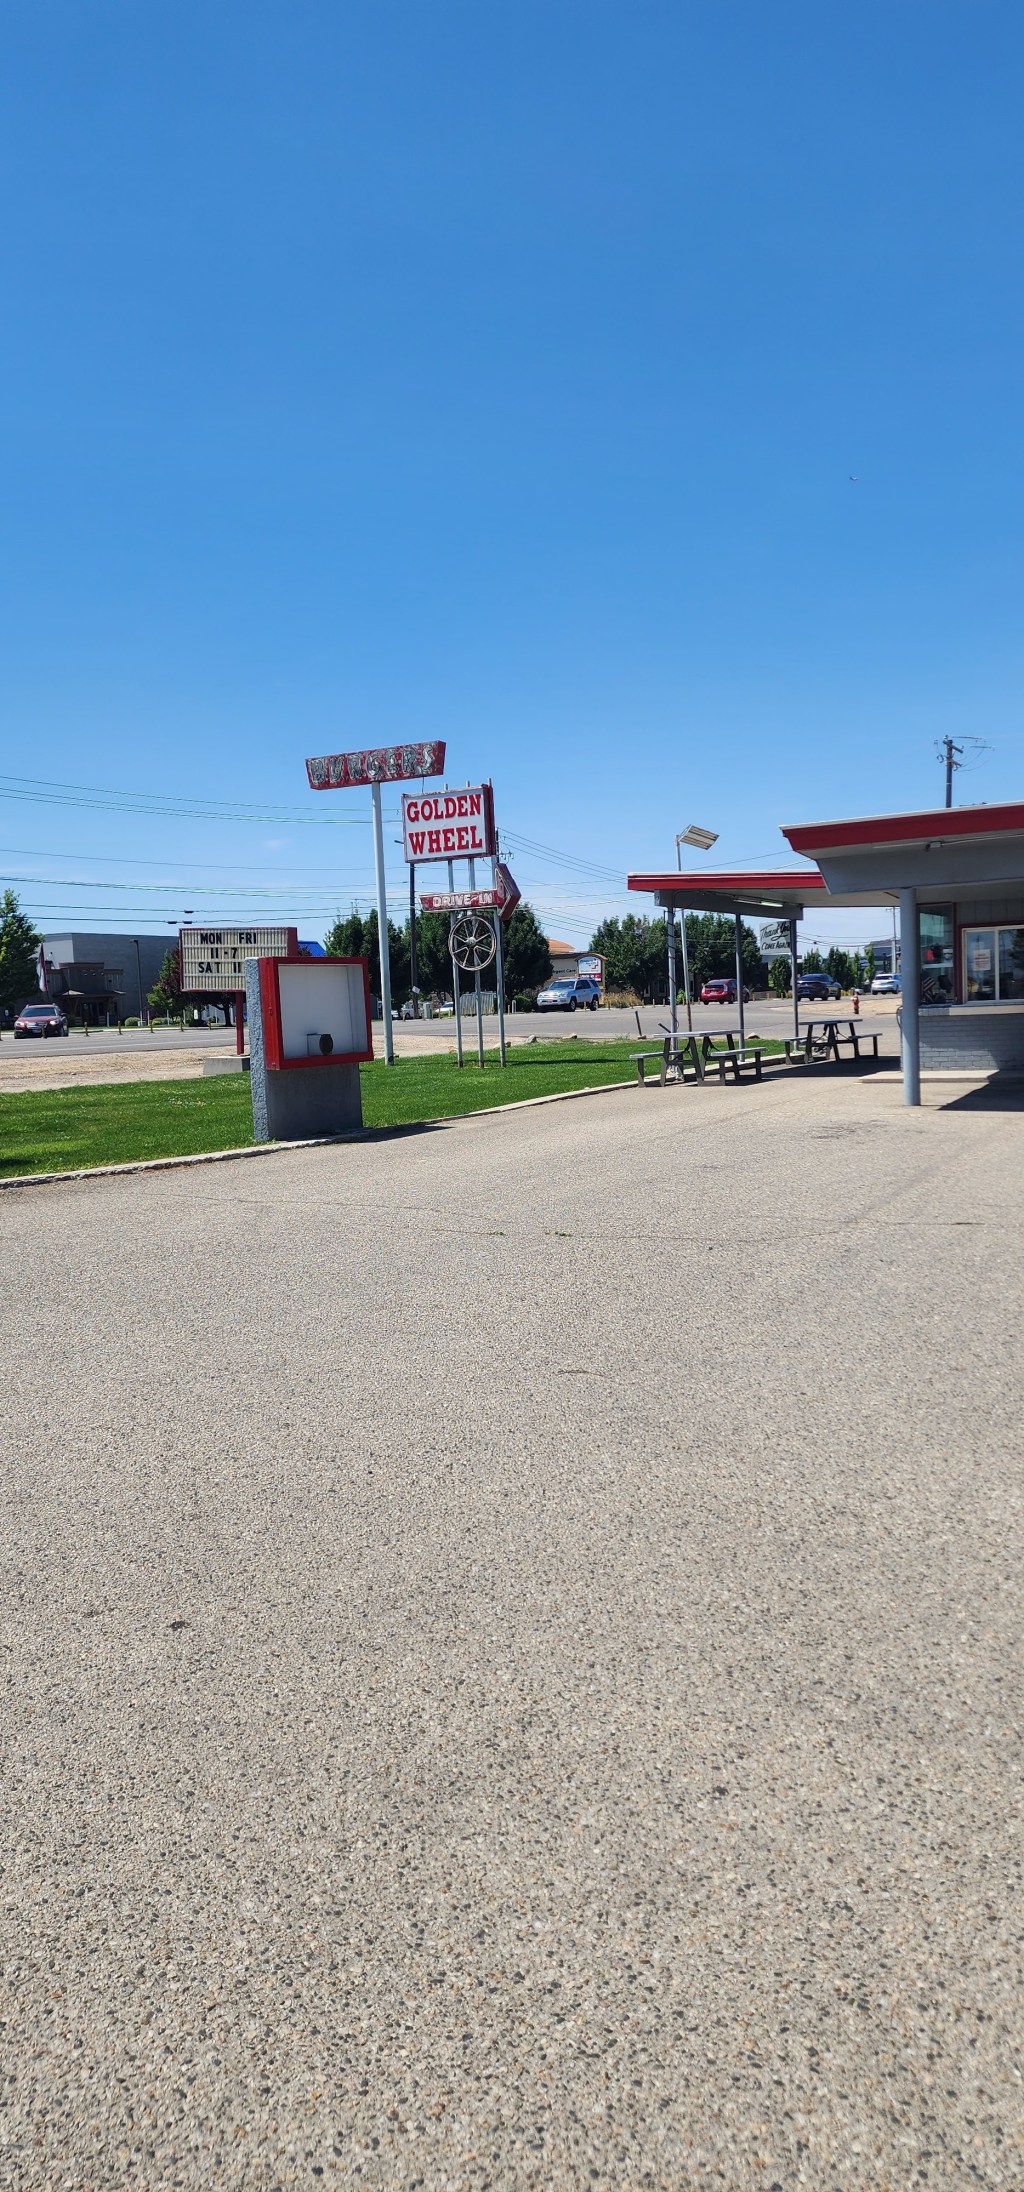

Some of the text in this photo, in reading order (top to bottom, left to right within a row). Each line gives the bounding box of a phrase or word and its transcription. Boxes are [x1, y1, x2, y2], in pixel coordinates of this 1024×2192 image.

[309, 744, 434, 785] BURGERS
[407, 794, 481, 822] GOLDEN
[409, 826, 482, 854] WHEEL
[432, 893, 493, 907] DRIVE-IN
[200, 932, 257, 945] MON FRI
[762, 942, 776, 950] COME
[198, 962, 221, 974] SAT
